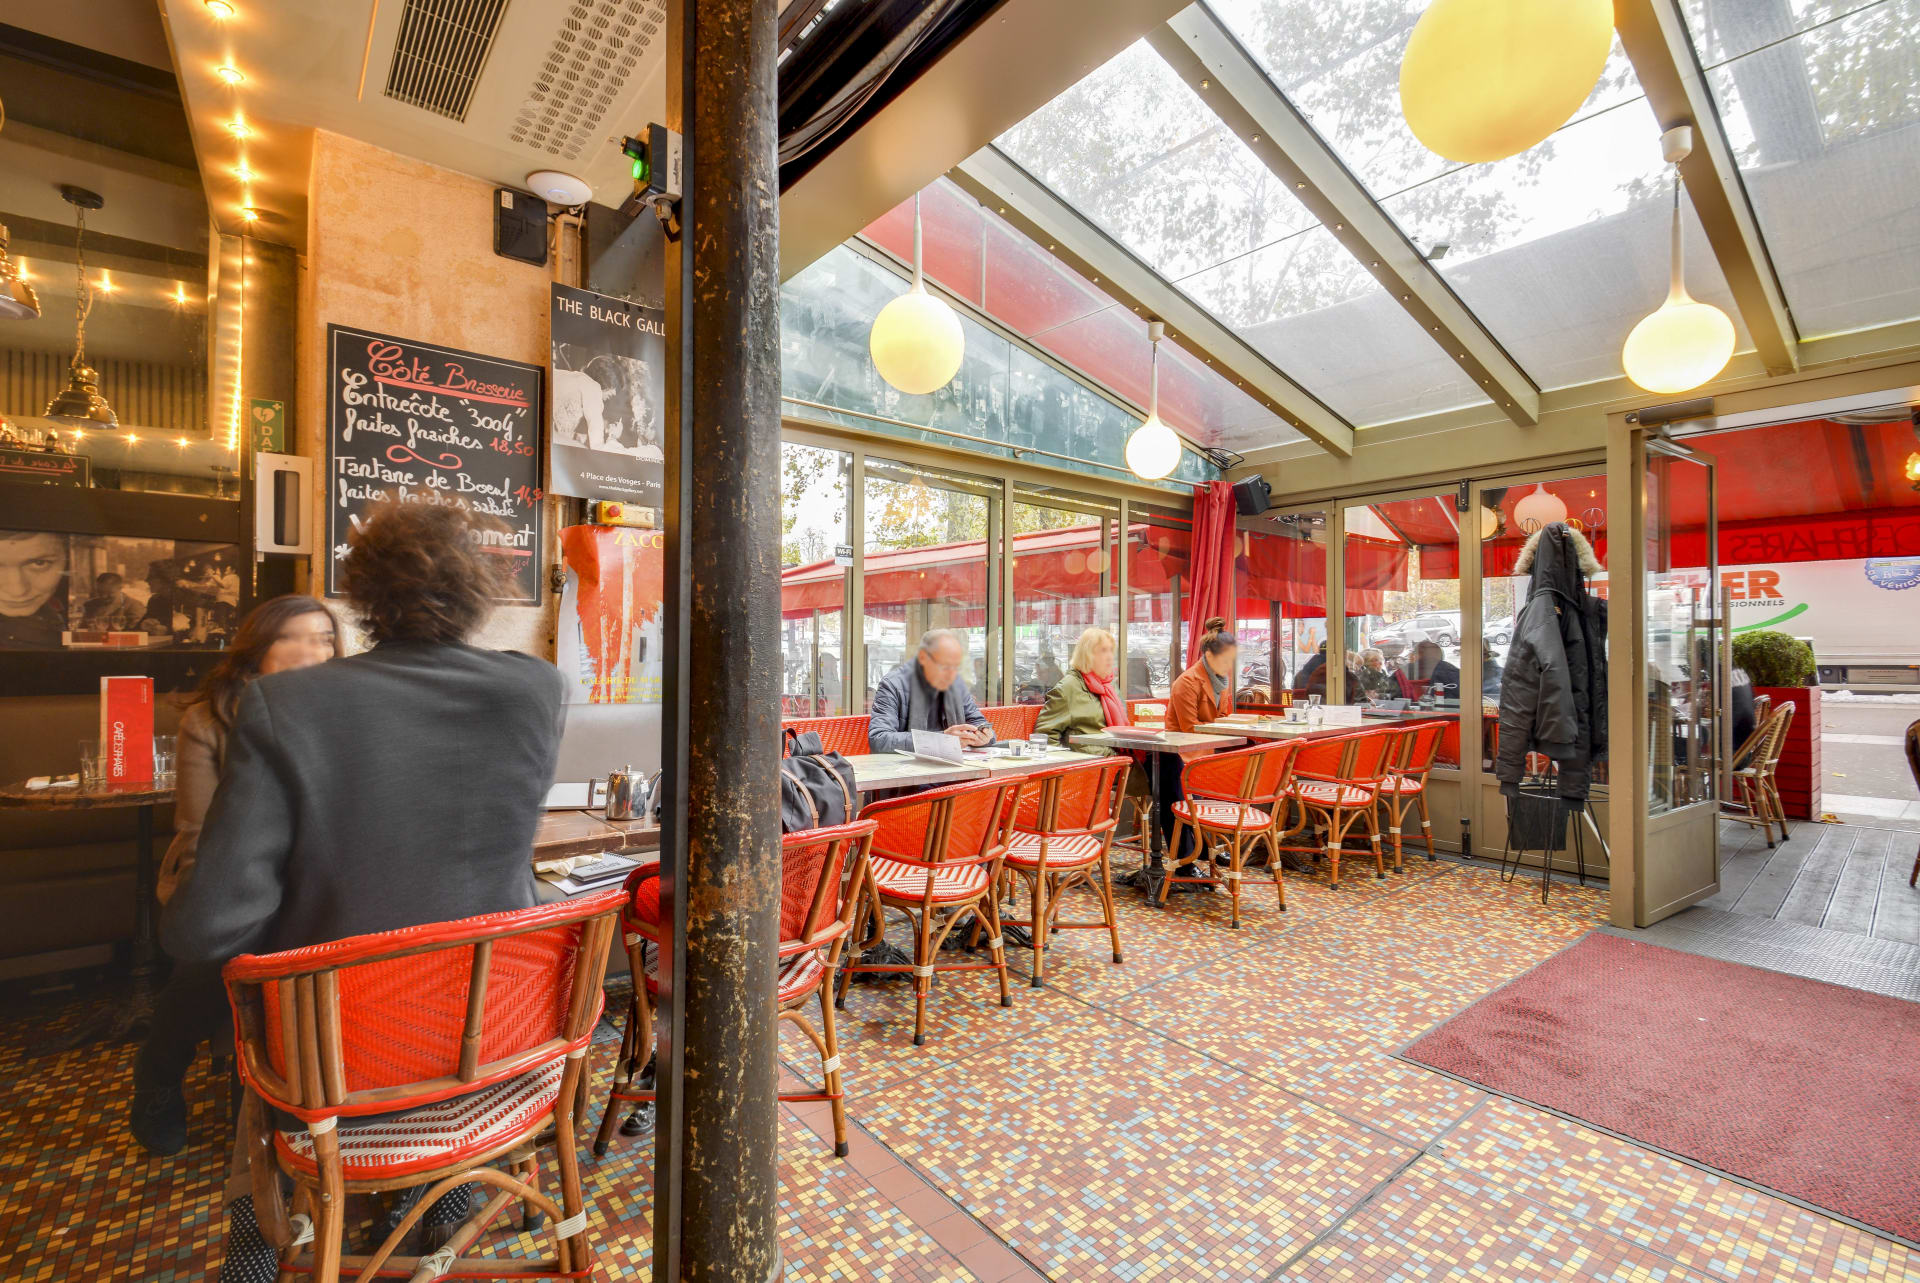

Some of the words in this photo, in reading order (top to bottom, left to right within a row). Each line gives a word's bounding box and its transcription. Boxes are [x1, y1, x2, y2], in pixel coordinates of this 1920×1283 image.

[557, 296, 583, 316] THE
[590, 305, 630, 328] BLACK
[367, 341, 434, 385] Côté
[438, 362, 529, 401] Brasserie
[341, 368, 453, 422] Entrecôte
[343, 408, 401, 442] frites
[489, 437, 535, 457] 18,50
[334, 456, 418, 486] Tartare
[425, 469, 451, 489] de
[580, 471, 585, 479] 4
[586, 471, 604, 481] Place
[605, 474, 617, 483] des
[618, 476, 641, 487] Vosges
[646, 480, 661, 489] Paris
[472, 496, 517, 517] salade
[464, 523, 535, 547] oment
